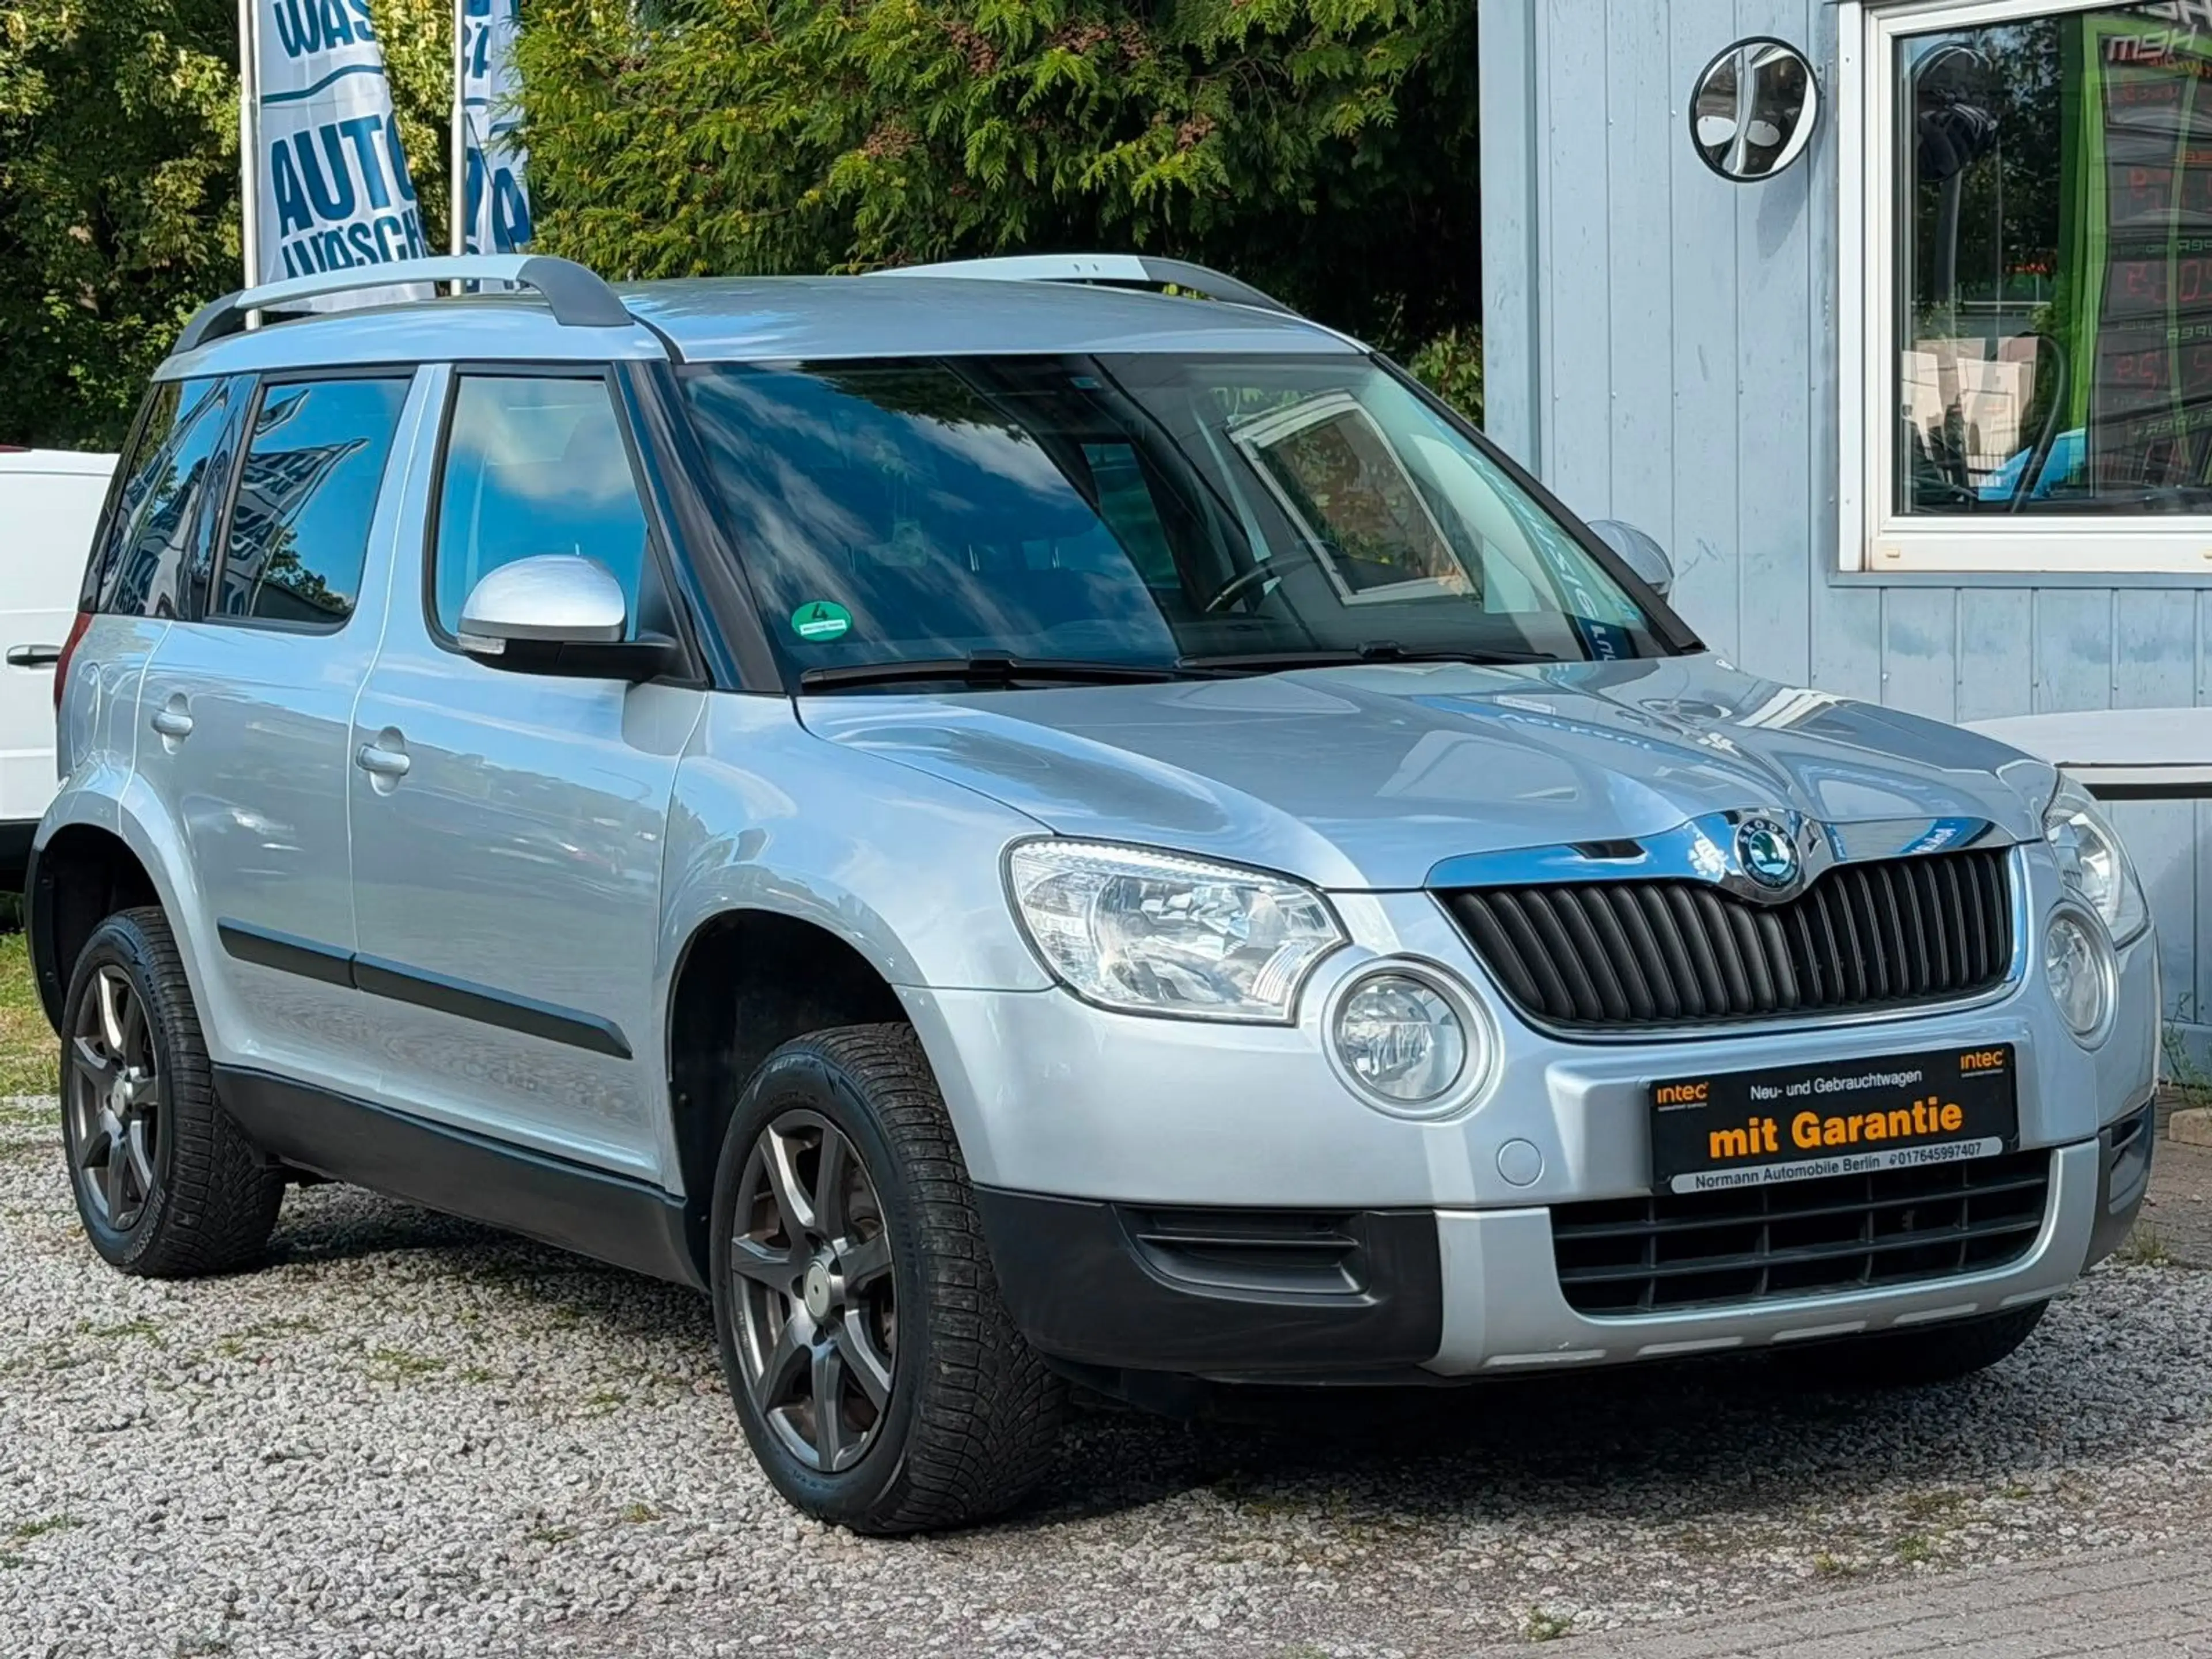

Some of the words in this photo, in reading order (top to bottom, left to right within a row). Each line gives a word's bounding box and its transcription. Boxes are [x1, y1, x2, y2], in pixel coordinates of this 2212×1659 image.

[1960, 1050, 2003, 1070] intec
[1657, 1084, 1707, 1104] intec
[1750, 1085, 1783, 1100] Neu-
[1786, 1080, 1811, 1096] und
[1815, 1070, 1923, 1093] Gebrauchtwagen
[1709, 1117, 1779, 1158] mit
[1791, 1096, 1963, 1149] Garantie
[1695, 1171, 1759, 1189] Normann
[1764, 1160, 1839, 1180] Automobile
[1843, 1155, 1880, 1172] Berlin
